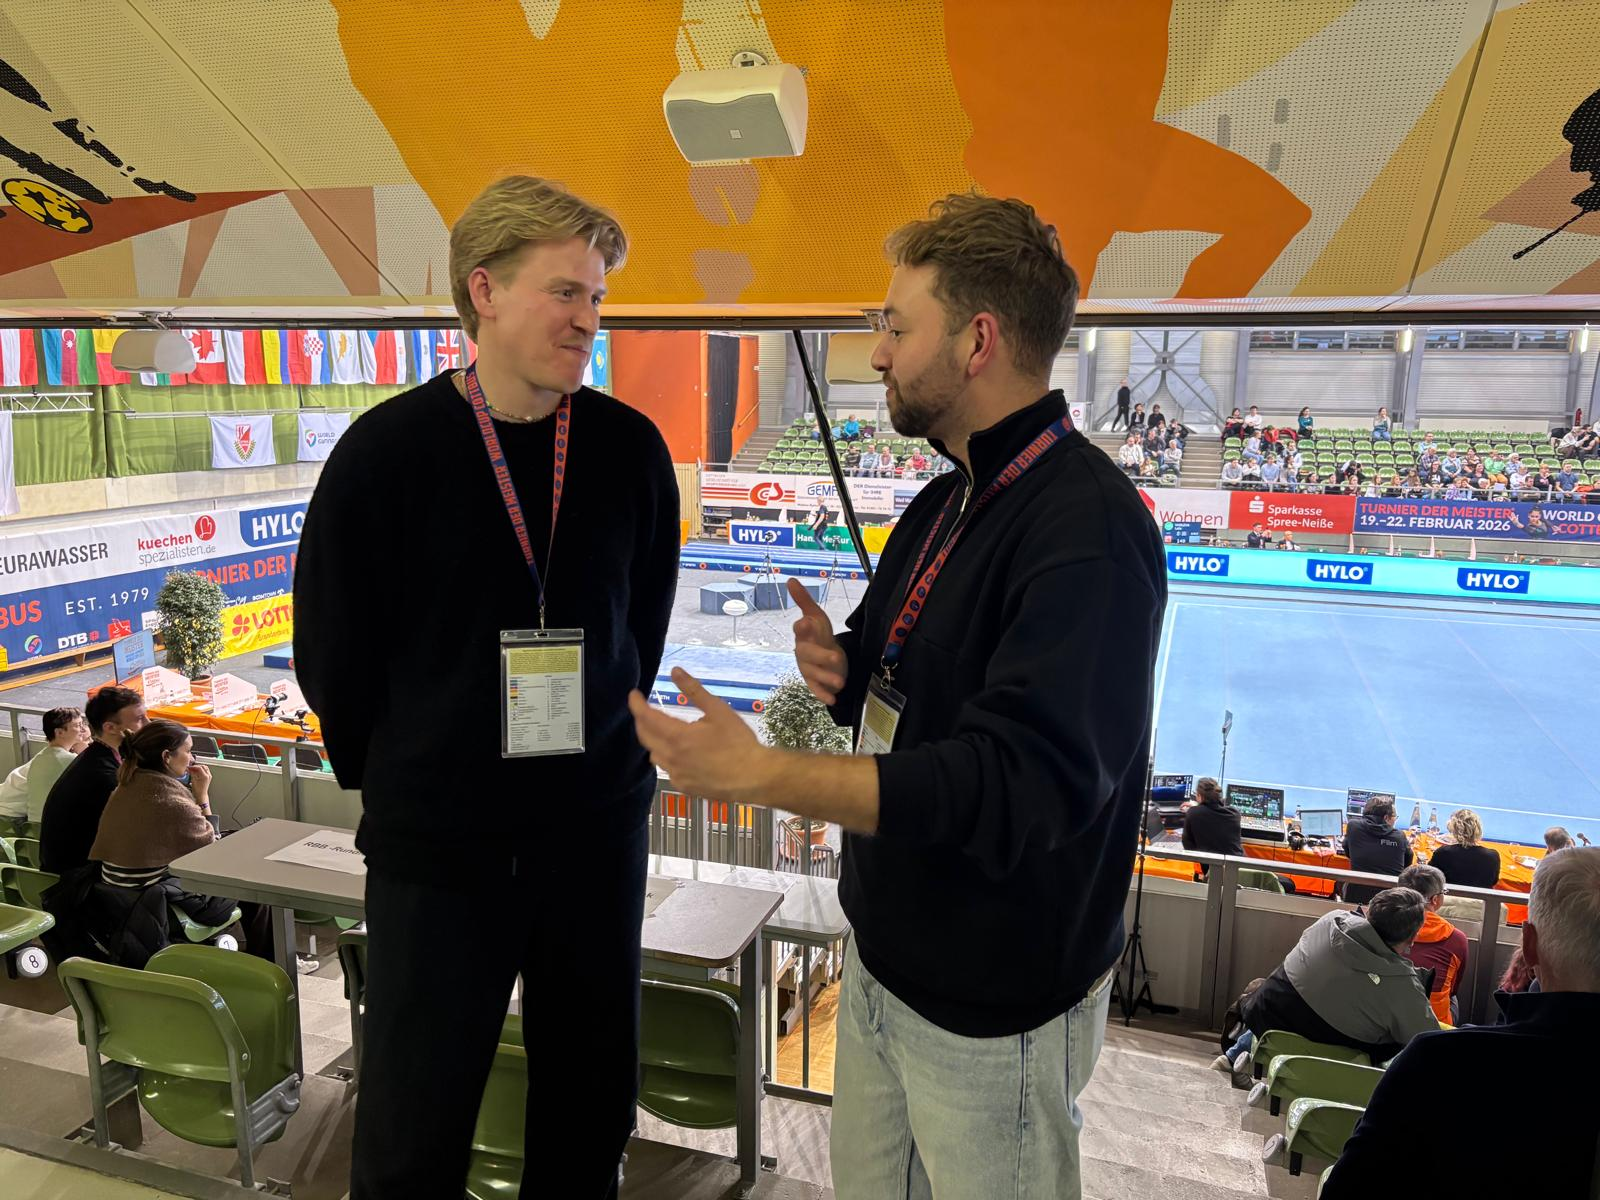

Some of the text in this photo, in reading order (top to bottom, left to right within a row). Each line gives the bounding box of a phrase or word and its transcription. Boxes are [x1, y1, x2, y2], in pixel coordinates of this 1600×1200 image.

[1014, 428, 1058, 470] TURNIER
[1268, 504, 1323, 516] Sparkasse
[1360, 503, 1418, 516] TURNIER
[1421, 505, 1449, 517] DER
[1542, 509, 1595, 522] WORLD
[1159, 511, 1223, 526] Wohnen
[1267, 516, 1334, 529] Spree-Neiße
[1409, 516, 1474, 530] FEBRUAR
[1476, 519, 1512, 531] 2026
[137, 534, 192, 551] kuechen
[139, 544, 216, 567] spezialisten.de
[253, 555, 287, 579] DER
[65, 586, 149, 616] EST. 1979
[252, 604, 293, 630] LOTT
[57, 632, 88, 649] DTB
[1380, 839, 1398, 847] Film
[29, 955, 39, 968] 8
